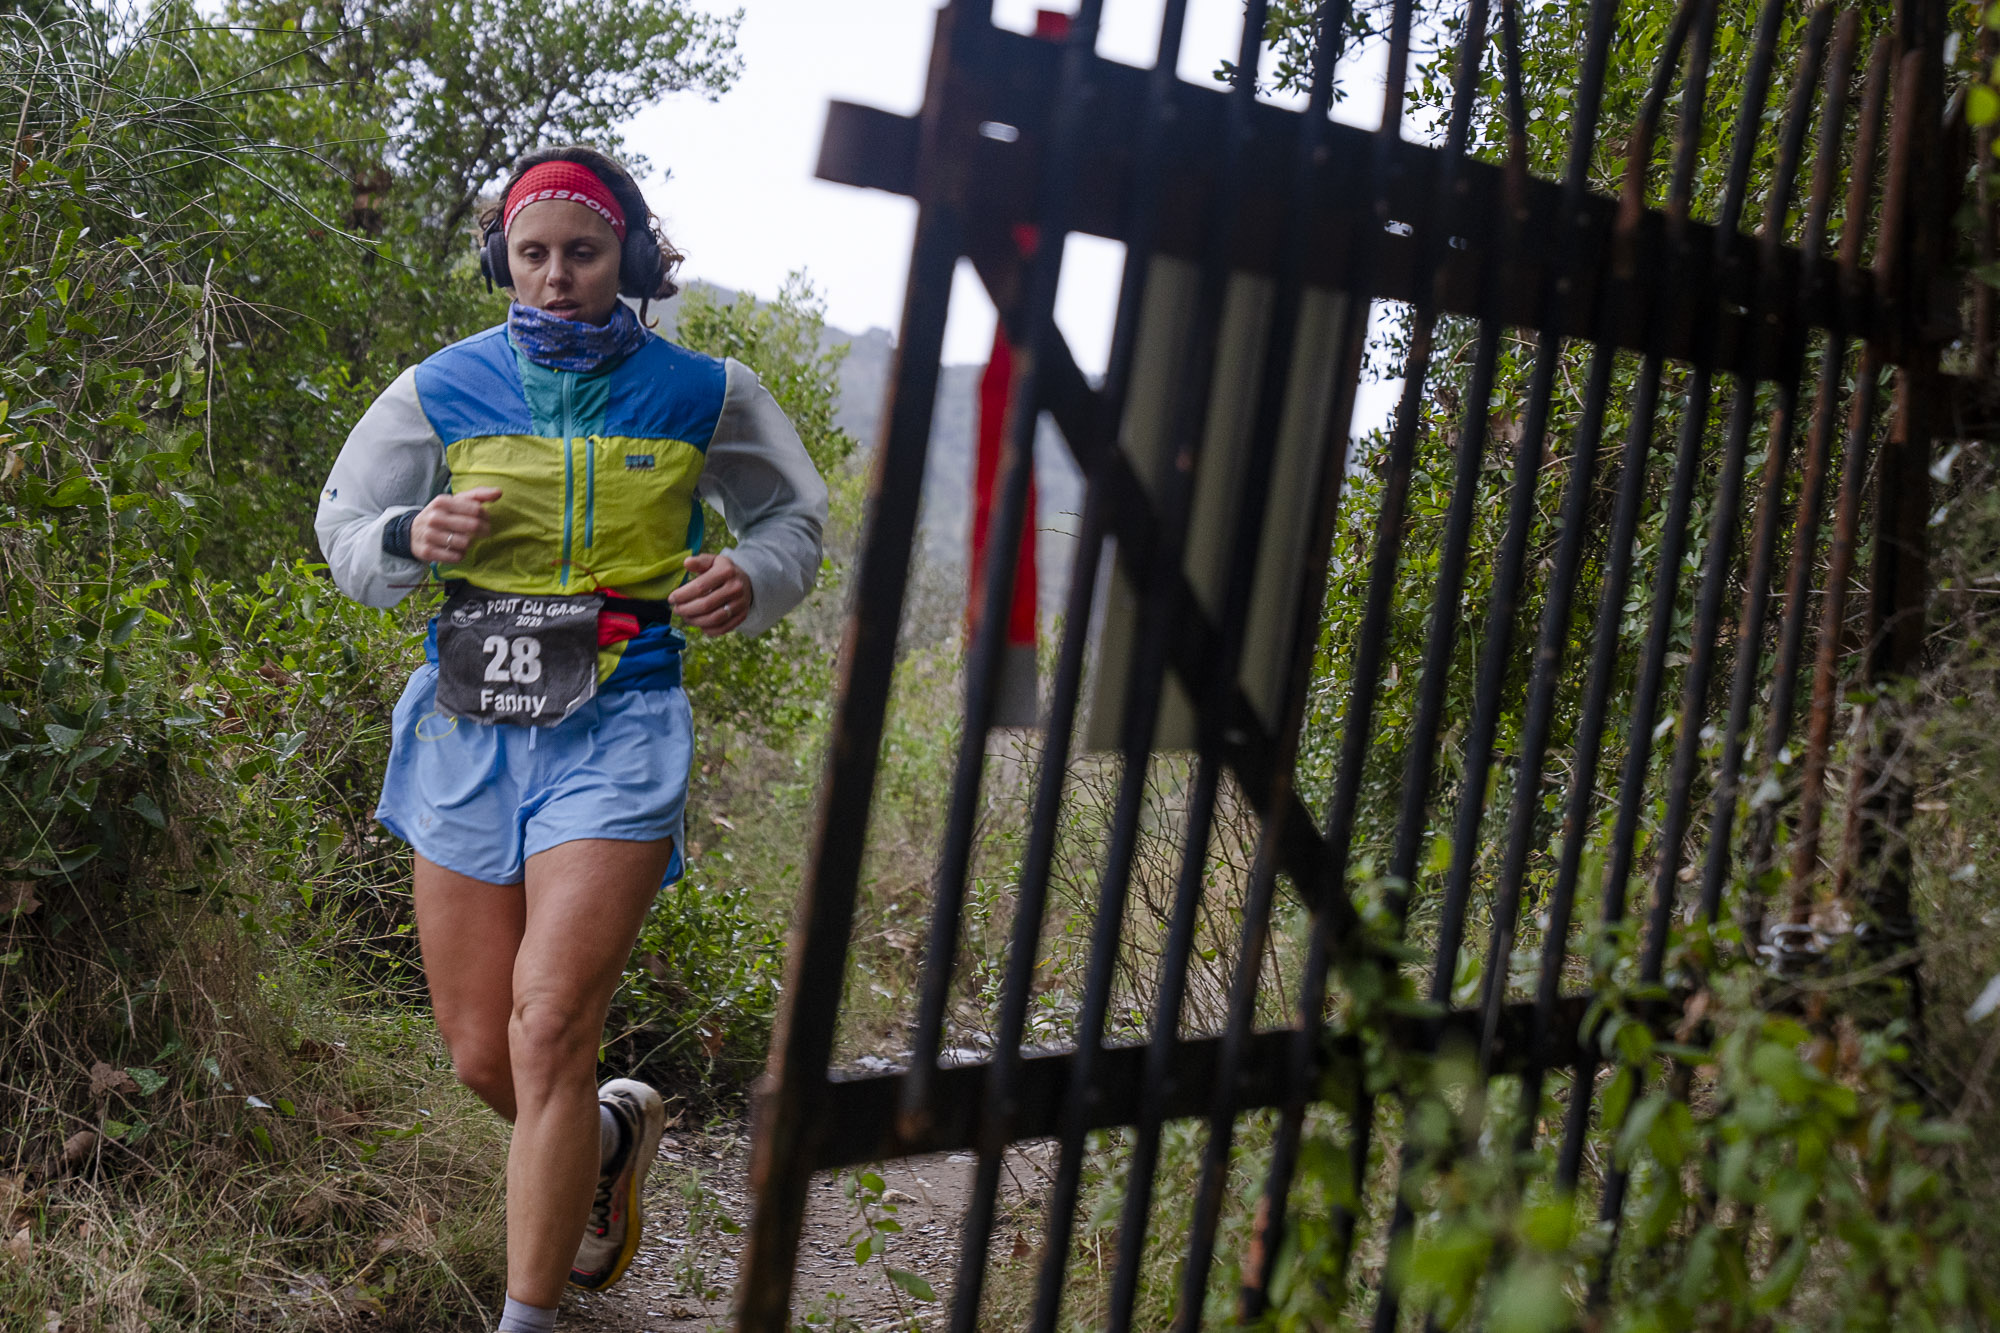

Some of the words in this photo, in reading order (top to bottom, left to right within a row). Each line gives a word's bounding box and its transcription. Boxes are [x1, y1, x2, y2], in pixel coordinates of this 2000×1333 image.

[486, 598, 521, 615] PONT
[521, 599, 544, 615] DU
[482, 634, 542, 684] 28
[480, 689, 547, 718] Fanny
